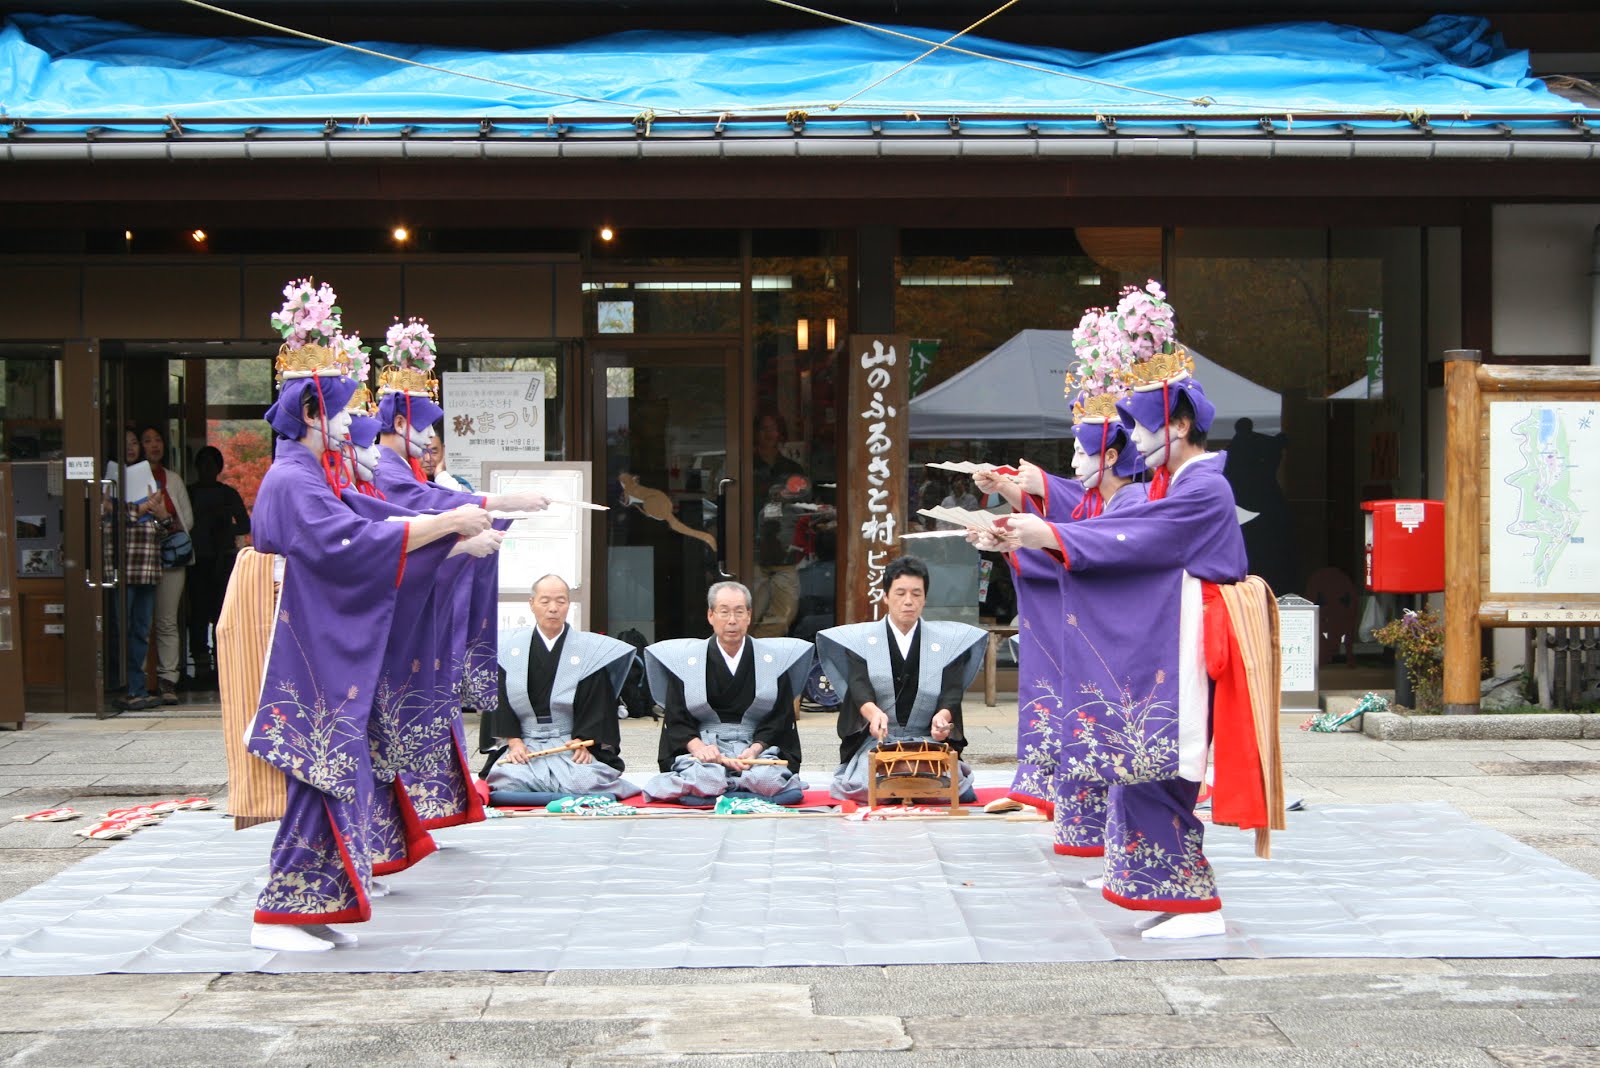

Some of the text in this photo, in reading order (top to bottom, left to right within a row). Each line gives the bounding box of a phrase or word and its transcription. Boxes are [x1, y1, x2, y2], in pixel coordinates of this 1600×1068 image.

[448, 399, 513, 409] 山のふるさと村
[452, 405, 539, 437] 秋まつり
[861, 340, 896, 621] 山のふるさと村 ビジター
